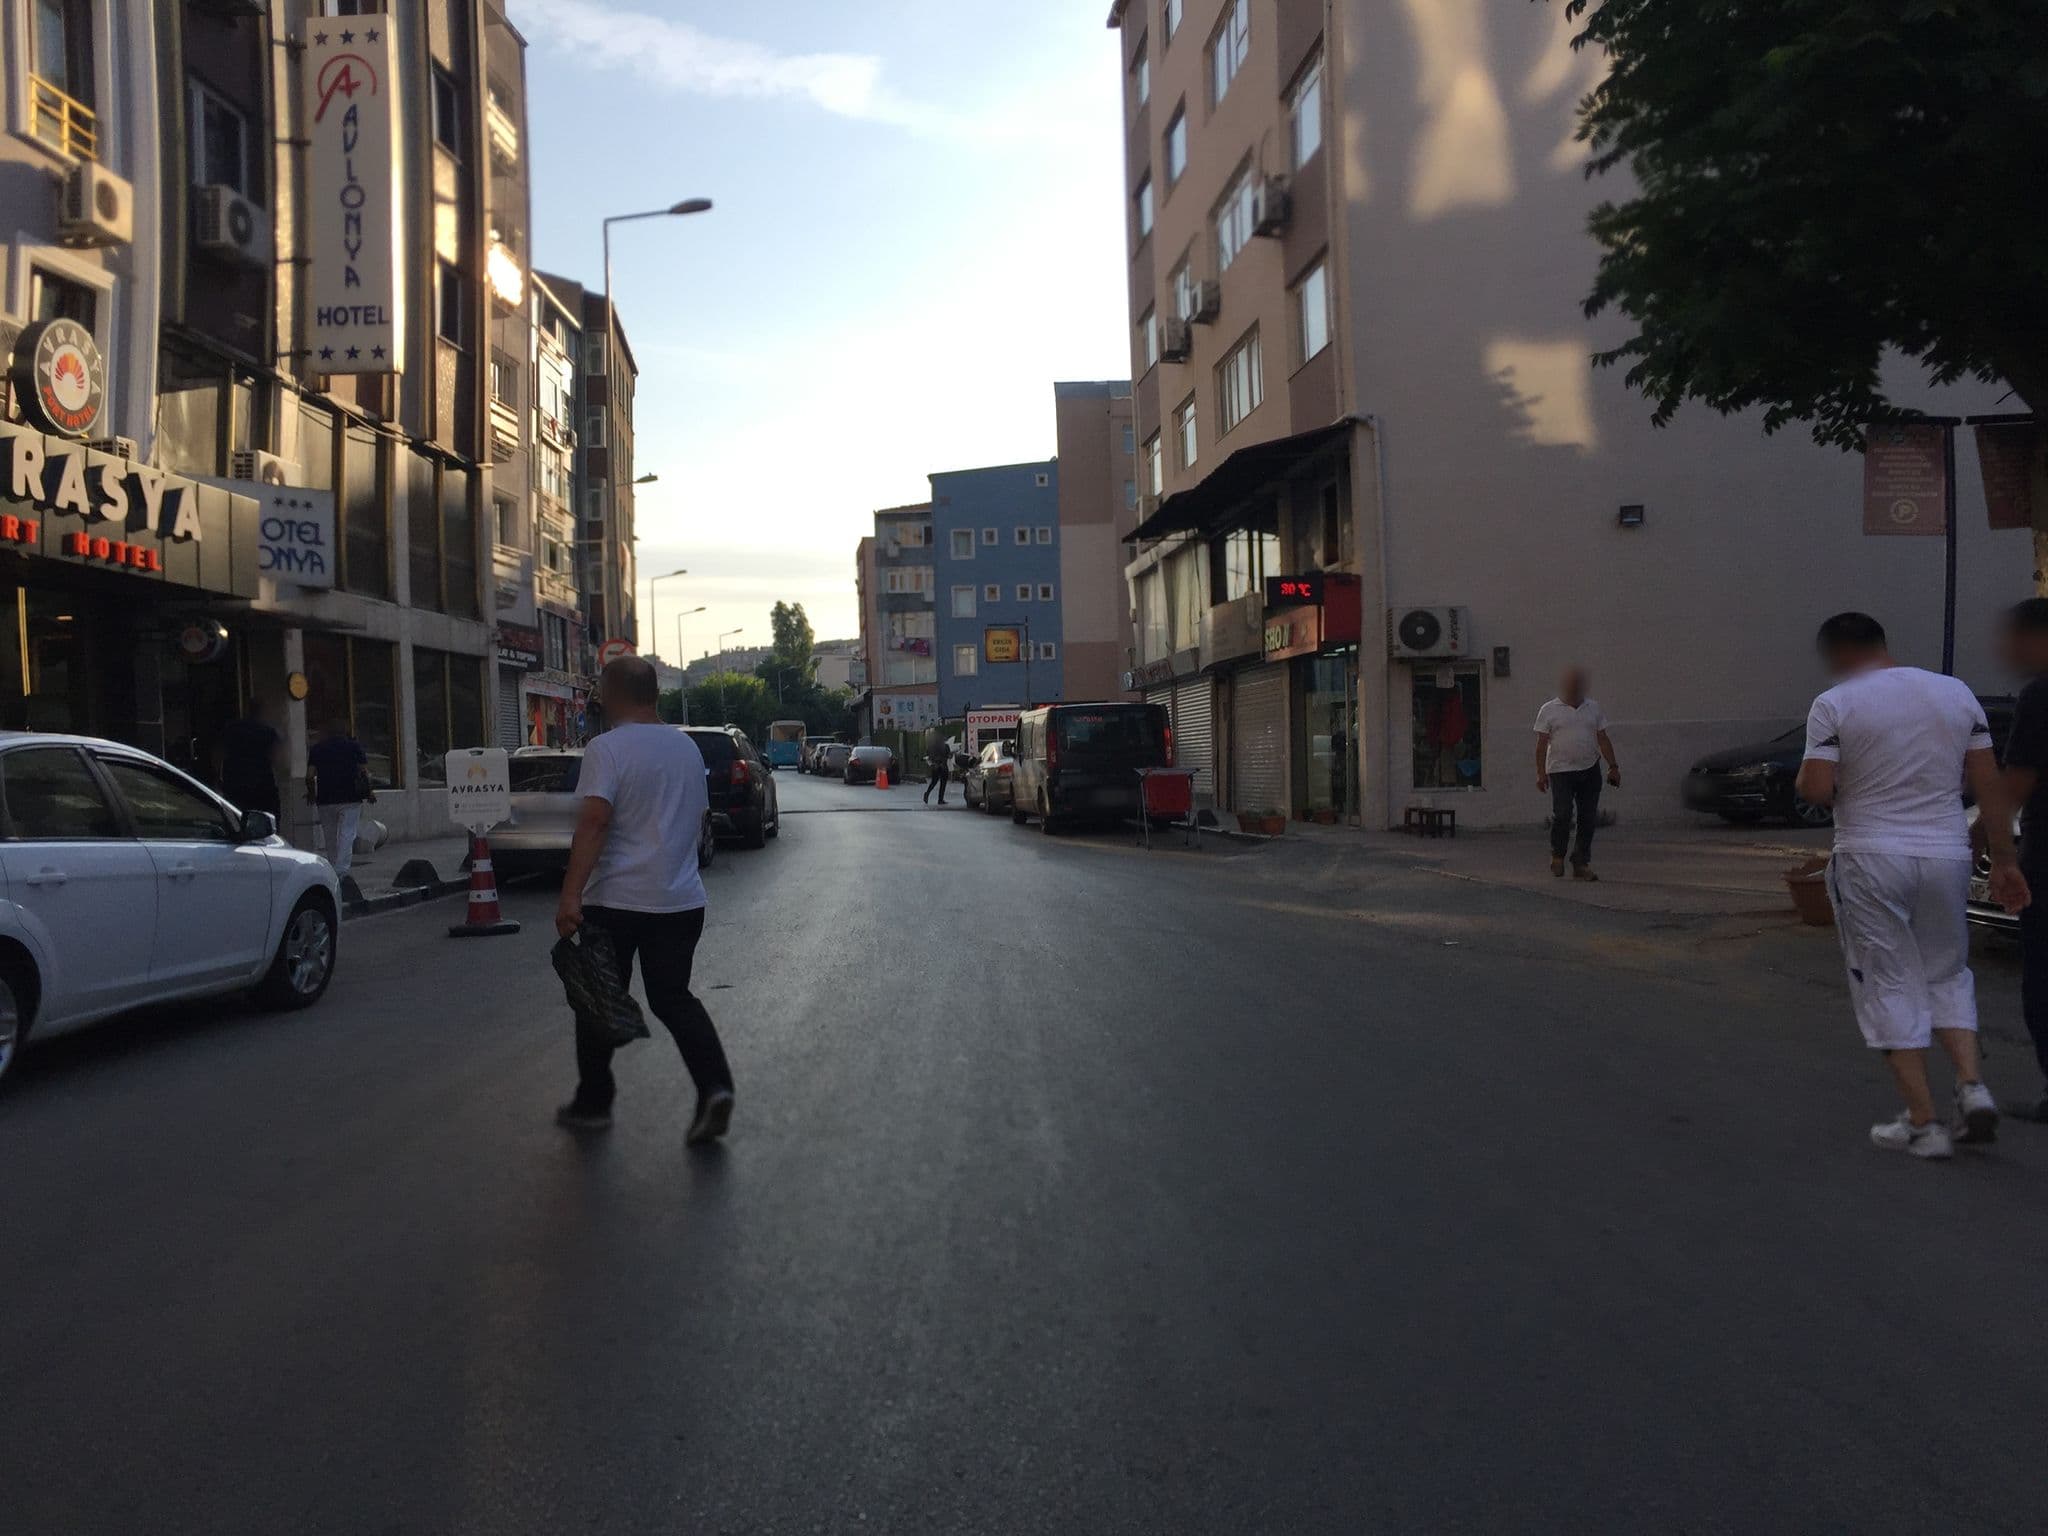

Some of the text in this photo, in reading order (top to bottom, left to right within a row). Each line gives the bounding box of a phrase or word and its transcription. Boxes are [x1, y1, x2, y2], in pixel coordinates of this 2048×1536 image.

[340, 104, 366, 288] AVLONYA
[317, 305, 390, 327] HOTEL
[13, 435, 202, 542] RASYA
[261, 517, 325, 546] OTEL
[72, 531, 163, 571] HOTEL
[968, 714, 1020, 724] OTOPARK
[451, 784, 505, 794] AVRASYA
